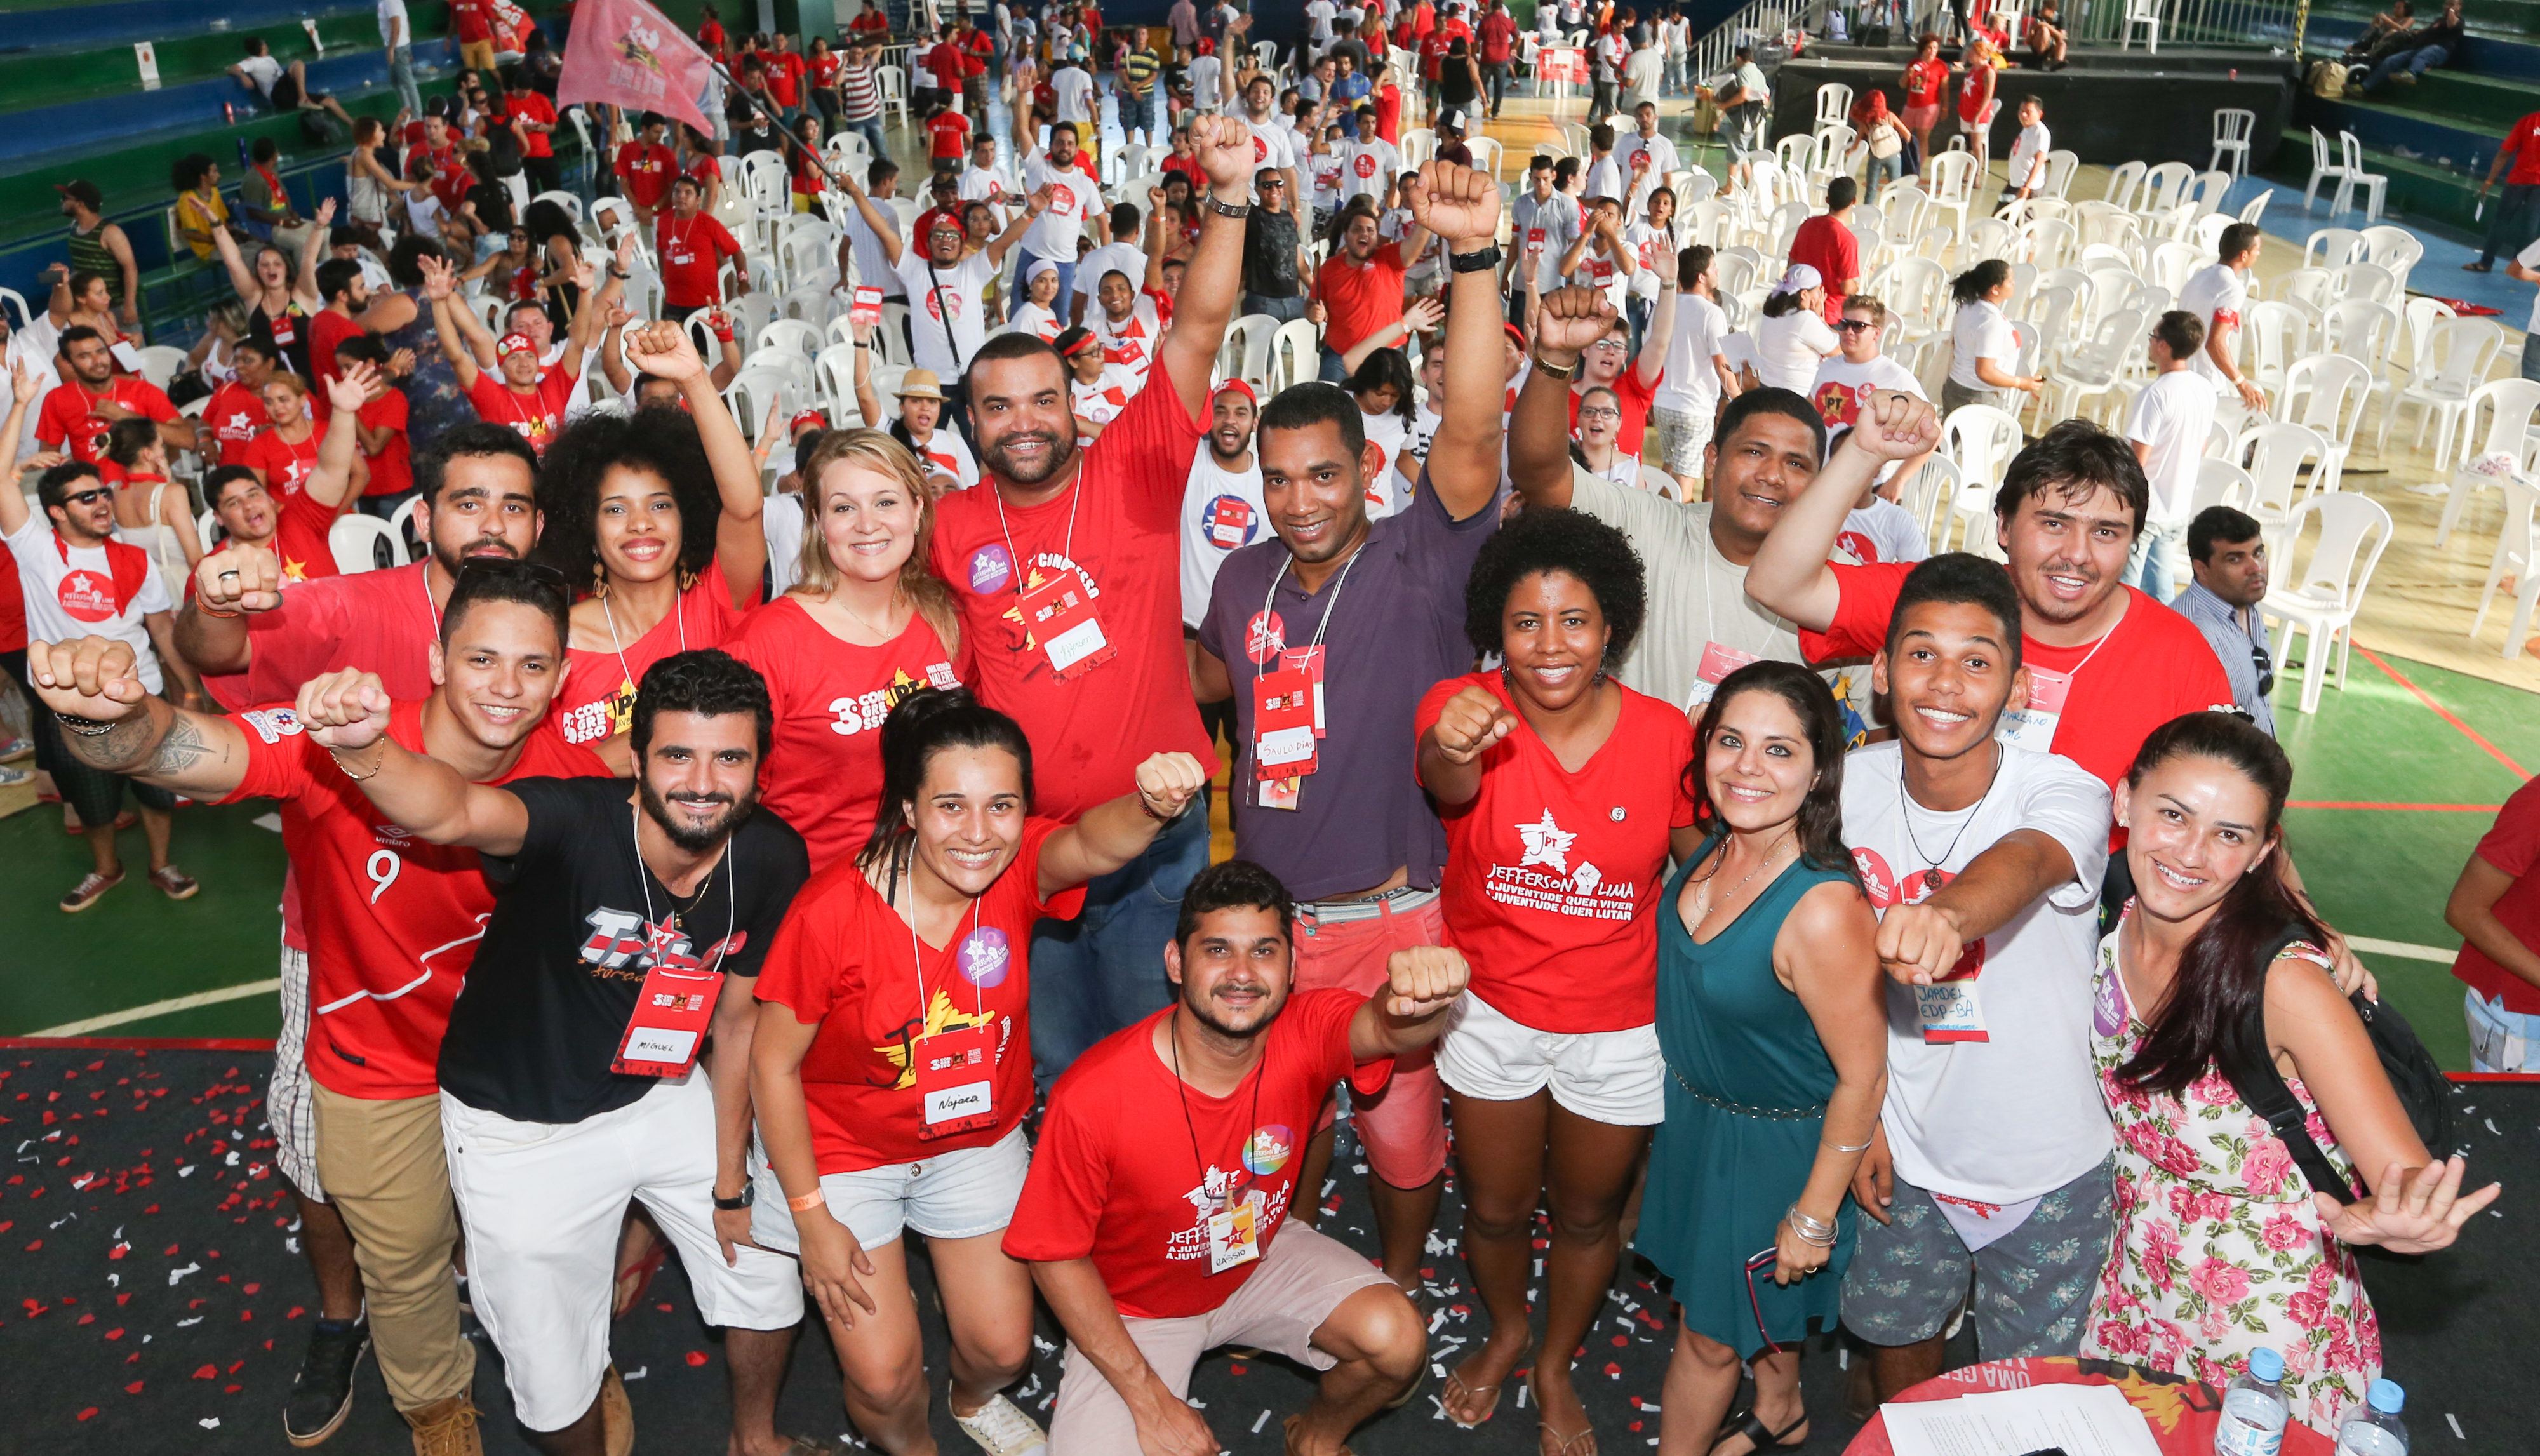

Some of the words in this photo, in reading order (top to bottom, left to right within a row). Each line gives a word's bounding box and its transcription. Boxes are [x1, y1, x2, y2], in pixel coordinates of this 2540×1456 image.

[858, 688, 886, 706] CON
[574, 700, 606, 720] CON
[861, 701, 888, 718] GRE
[577, 712, 606, 731] GRE
[577, 725, 606, 744] SSO
[375, 836, 410, 848] umbro
[366, 848, 401, 905] 9
[1486, 862, 1574, 893] JEFFERSON
[1597, 881, 1634, 900] LIMA
[1486, 880, 1494, 891] A
[1495, 882, 1564, 903] JUVENTUDE
[1565, 895, 1598, 909] QUER
[1600, 899, 1634, 911] VIVER
[1492, 892, 1559, 912] JUVENTUDE
[1561, 904, 1594, 918] QUER
[1595, 908, 1633, 921] LUTAR
[650, 928, 675, 945] PT
[1228, 1231, 1242, 1245] PT
